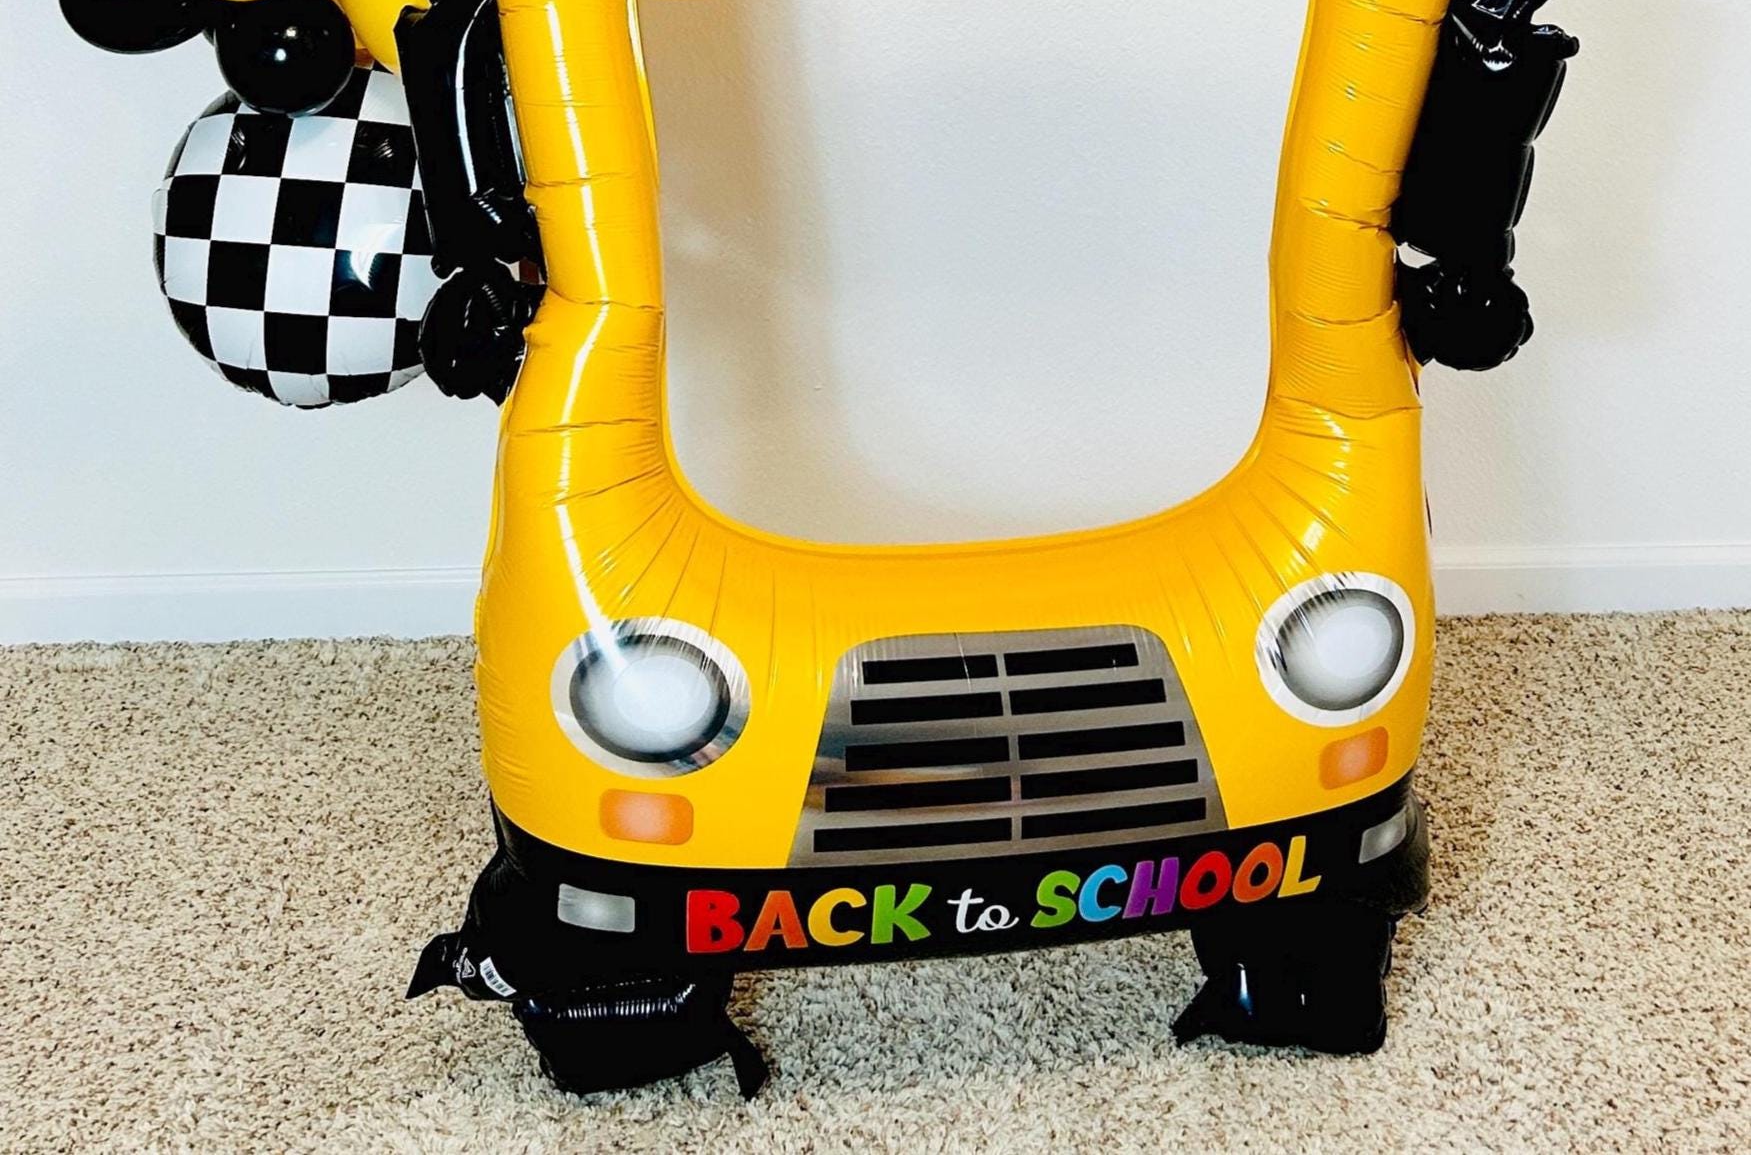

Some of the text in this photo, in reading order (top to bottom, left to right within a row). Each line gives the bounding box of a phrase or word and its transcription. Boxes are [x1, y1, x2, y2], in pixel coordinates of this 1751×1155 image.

[686, 835, 1322, 953] BACK to SCHOOL
